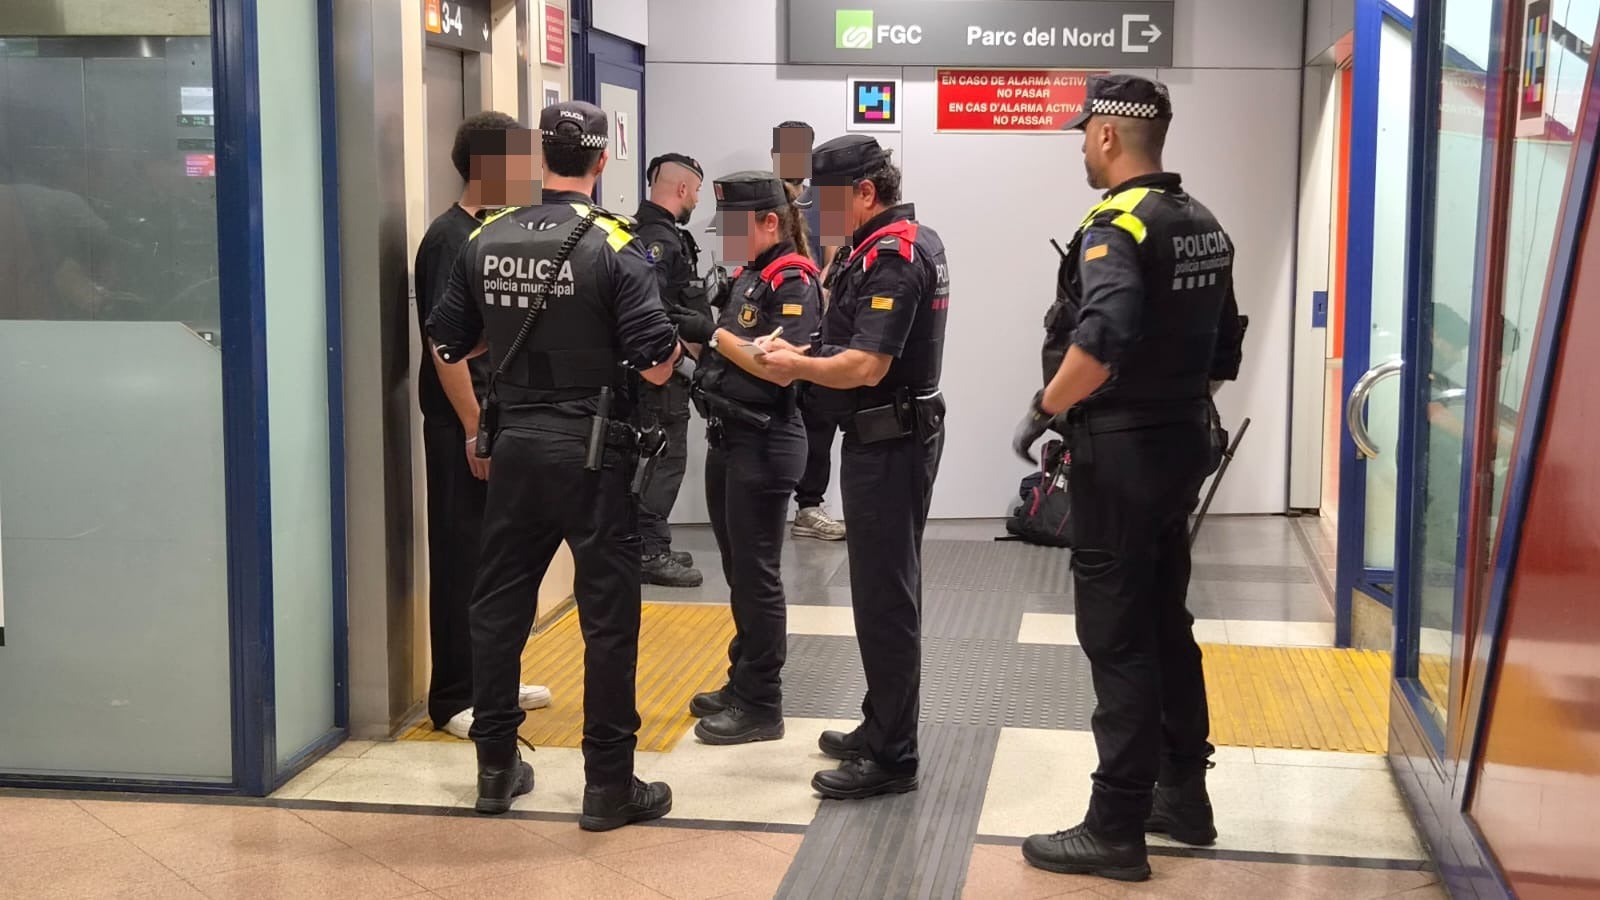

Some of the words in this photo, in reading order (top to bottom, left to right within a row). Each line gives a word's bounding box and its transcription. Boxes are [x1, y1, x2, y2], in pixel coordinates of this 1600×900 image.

[442, 1, 463, 36] 3-4
[877, 24, 922, 44] FGC
[967, 25, 1016, 46] Parc
[1022, 27, 1056, 47] del
[1062, 27, 1115, 47] Nord
[942, 76, 956, 85] EN
[958, 76, 988, 86] CASO
[990, 76, 1005, 85] DE
[1007, 76, 1051, 86] ALARMA
[996, 89, 1012, 98] NO
[1015, 89, 1050, 98] PASAR
[949, 103, 963, 112] EN
[965, 103, 987, 113] CAS
[989, 103, 1043, 113] D'ALARMA
[993, 116, 1009, 125] NO
[1011, 116, 1053, 125] PASSAR
[1172, 231, 1229, 259] POLICIA
[484, 255, 574, 281] POLICA
[484, 278, 517, 291] policia
